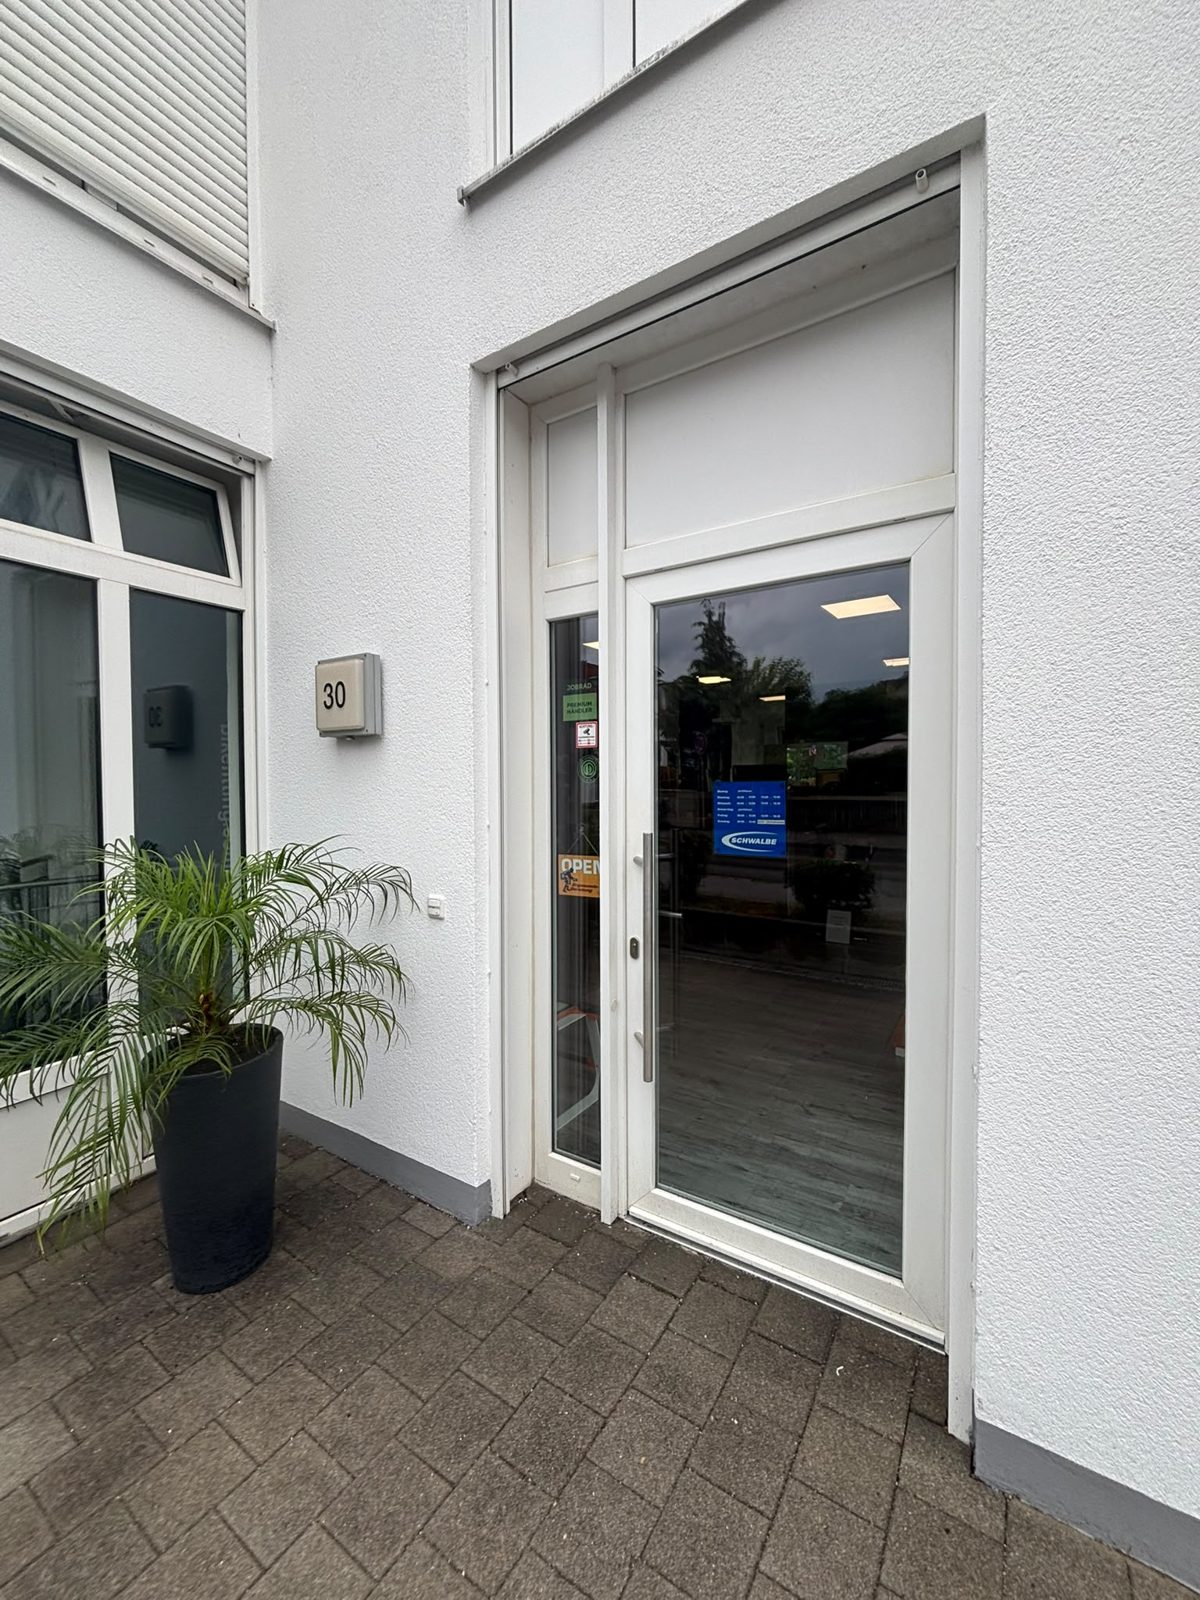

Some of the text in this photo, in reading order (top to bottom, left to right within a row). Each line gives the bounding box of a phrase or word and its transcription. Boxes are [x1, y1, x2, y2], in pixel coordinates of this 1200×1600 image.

[323, 681, 346, 710] 30
[731, 837, 777, 845] SCHWALBE
[561, 858, 600, 874] OPEN
